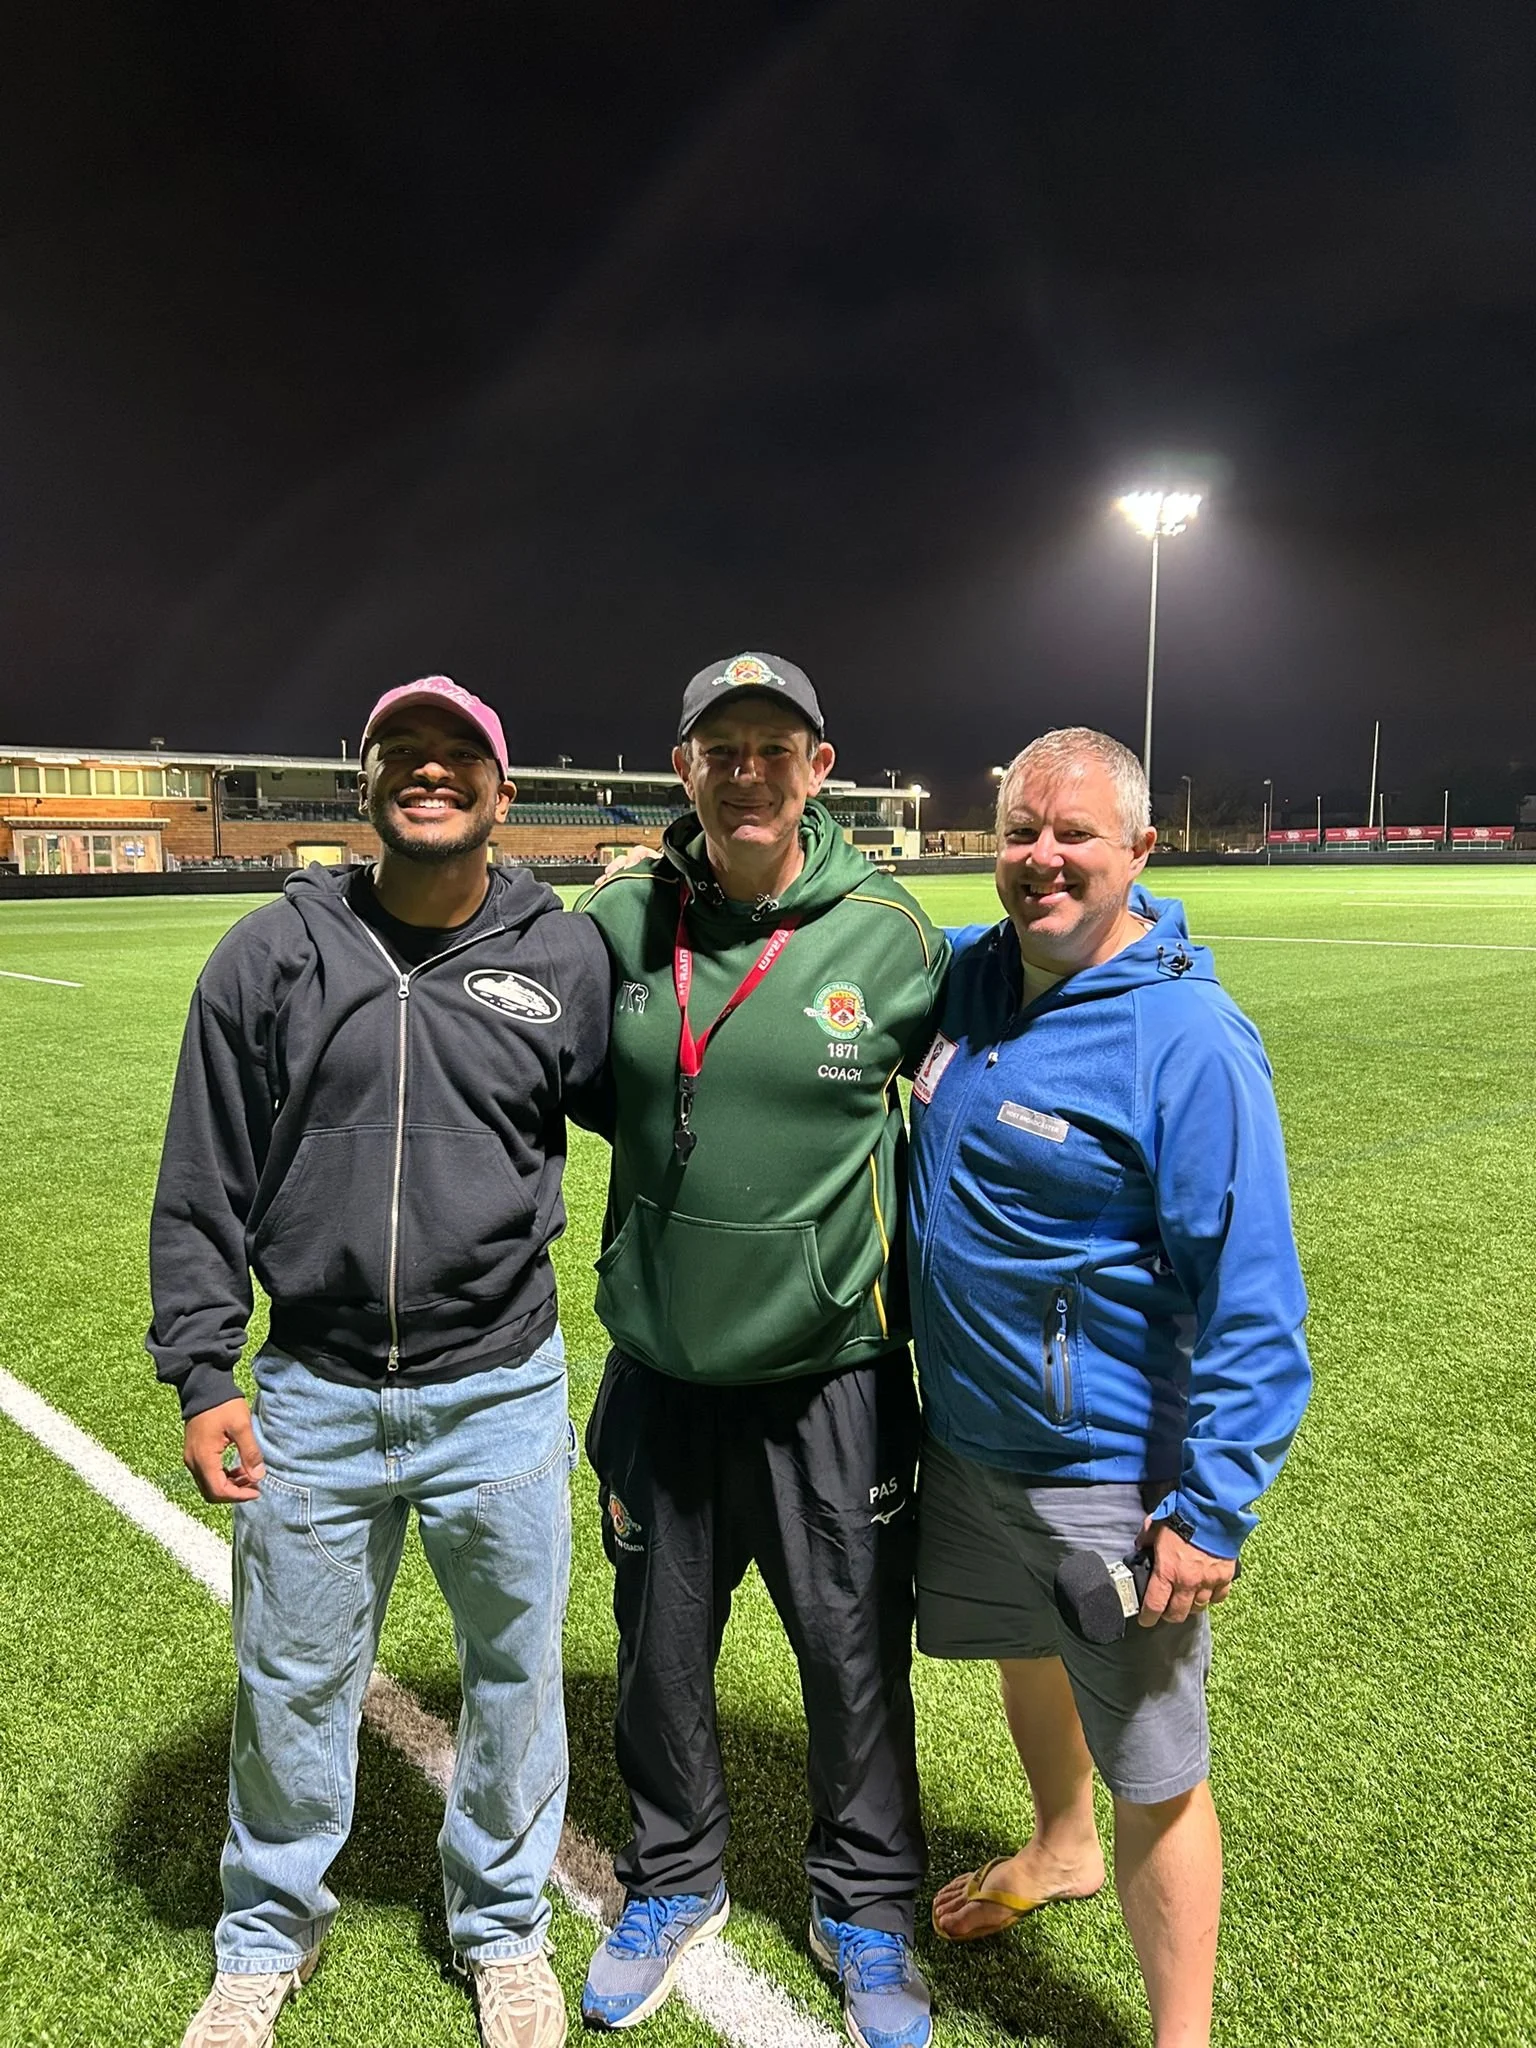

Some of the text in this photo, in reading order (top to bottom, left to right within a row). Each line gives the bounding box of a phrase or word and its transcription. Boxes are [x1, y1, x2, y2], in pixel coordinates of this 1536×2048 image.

[758, 940, 781, 970] RAM
[827, 1042, 858, 1060] 1871
[818, 1064, 862, 1081] COACH
[869, 1476, 898, 1504] PAS
